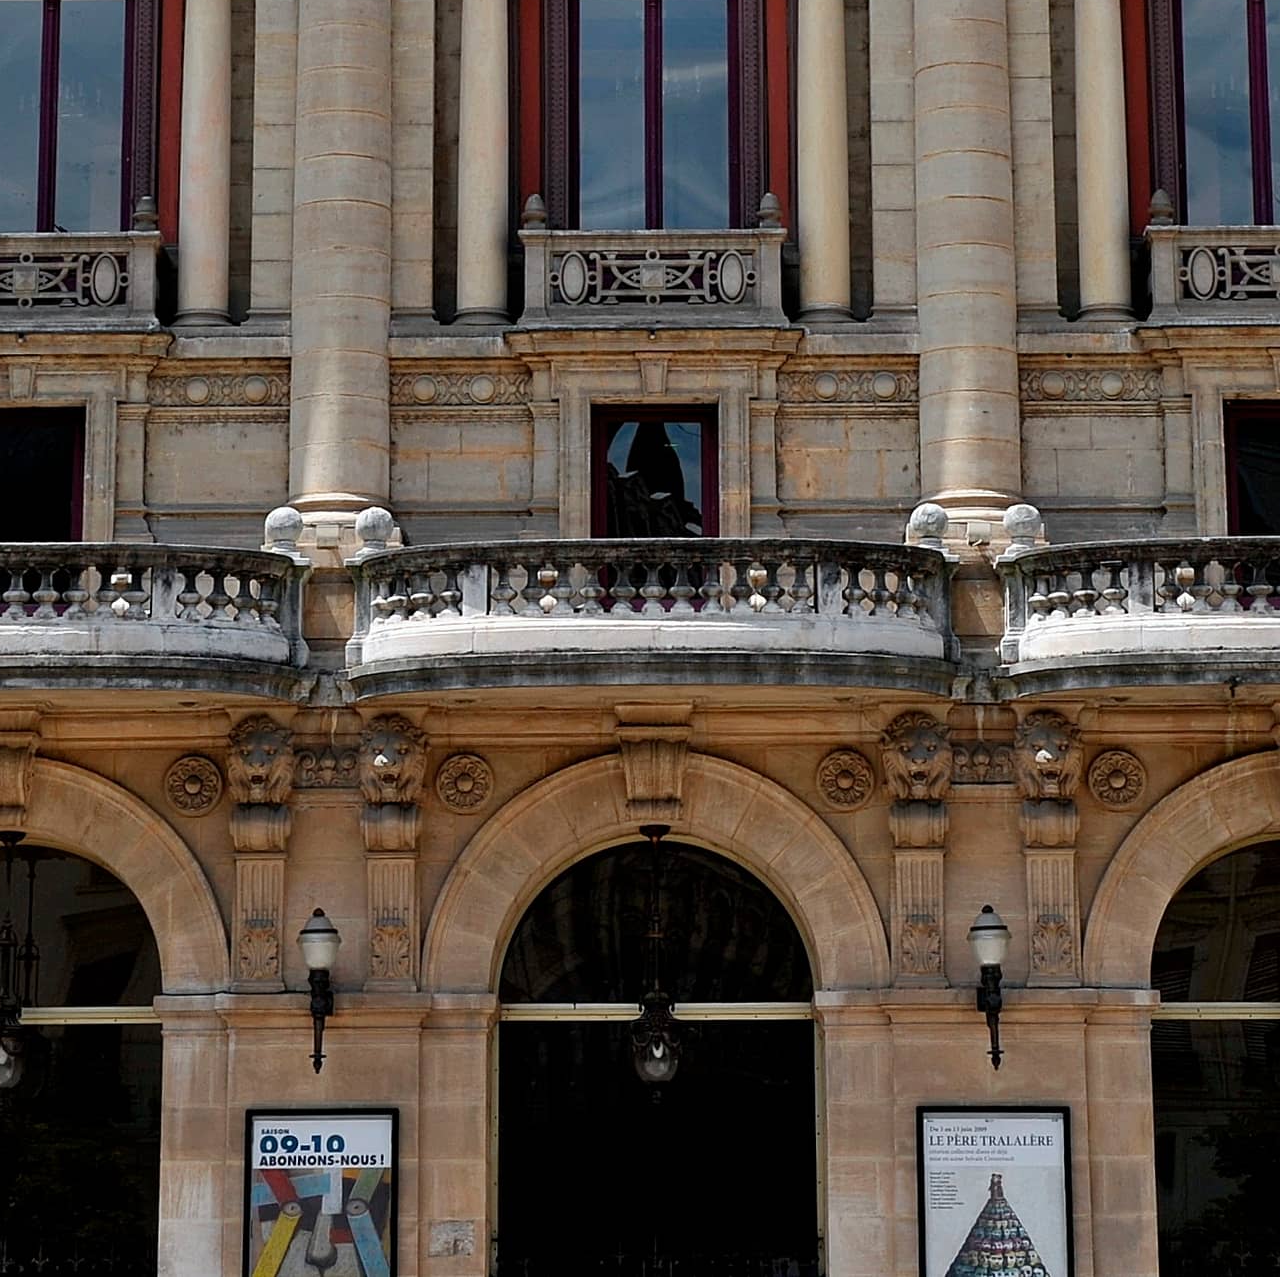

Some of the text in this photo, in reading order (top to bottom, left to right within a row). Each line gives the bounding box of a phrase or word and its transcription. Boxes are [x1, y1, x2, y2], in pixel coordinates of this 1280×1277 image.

[260, 1134, 345, 1153] 09-10
[929, 1133, 1054, 1146] LE PÈRE TRALALÈRE
[259, 1154, 385, 1166] ABONNONS-NOUS !
